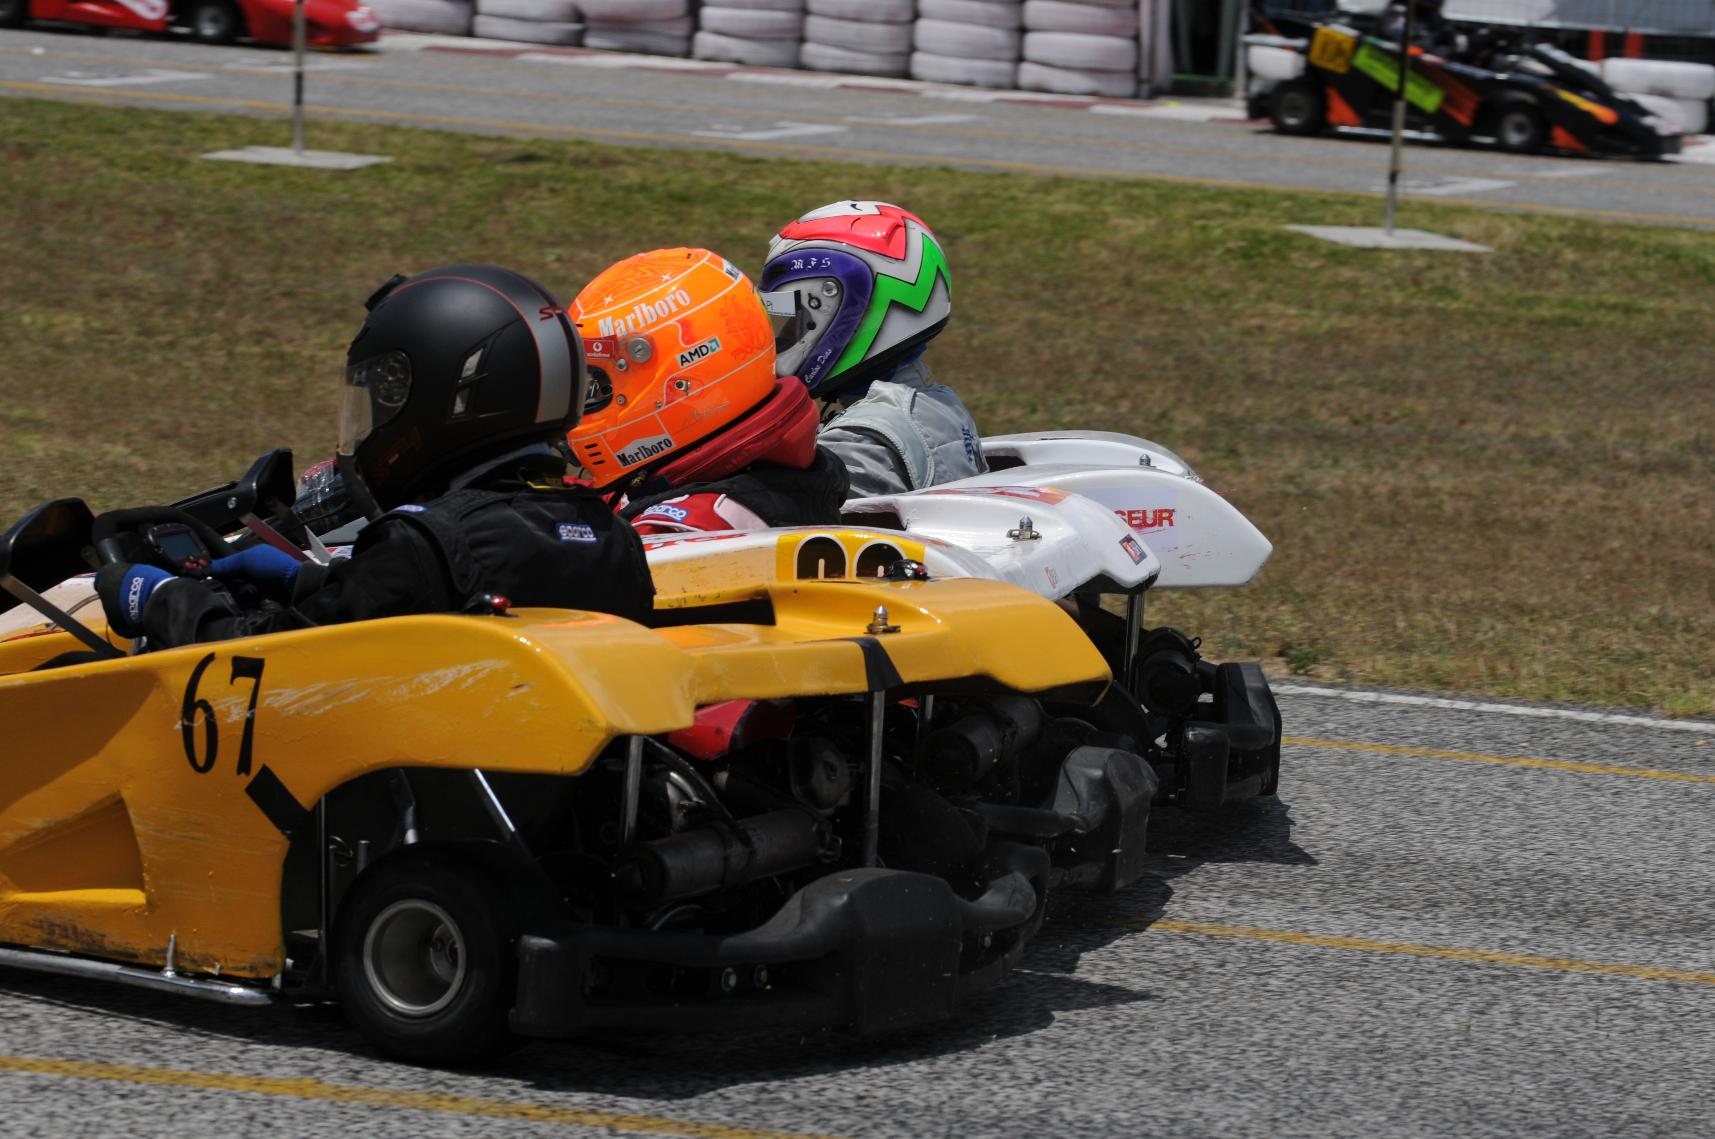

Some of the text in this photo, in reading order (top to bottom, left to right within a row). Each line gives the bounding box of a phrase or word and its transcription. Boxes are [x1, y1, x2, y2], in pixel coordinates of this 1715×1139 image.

[598, 288, 691, 337] Marlboro
[680, 344, 710, 367] AMD
[616, 438, 673, 467] Marlboro
[181, 652, 265, 776] 67
